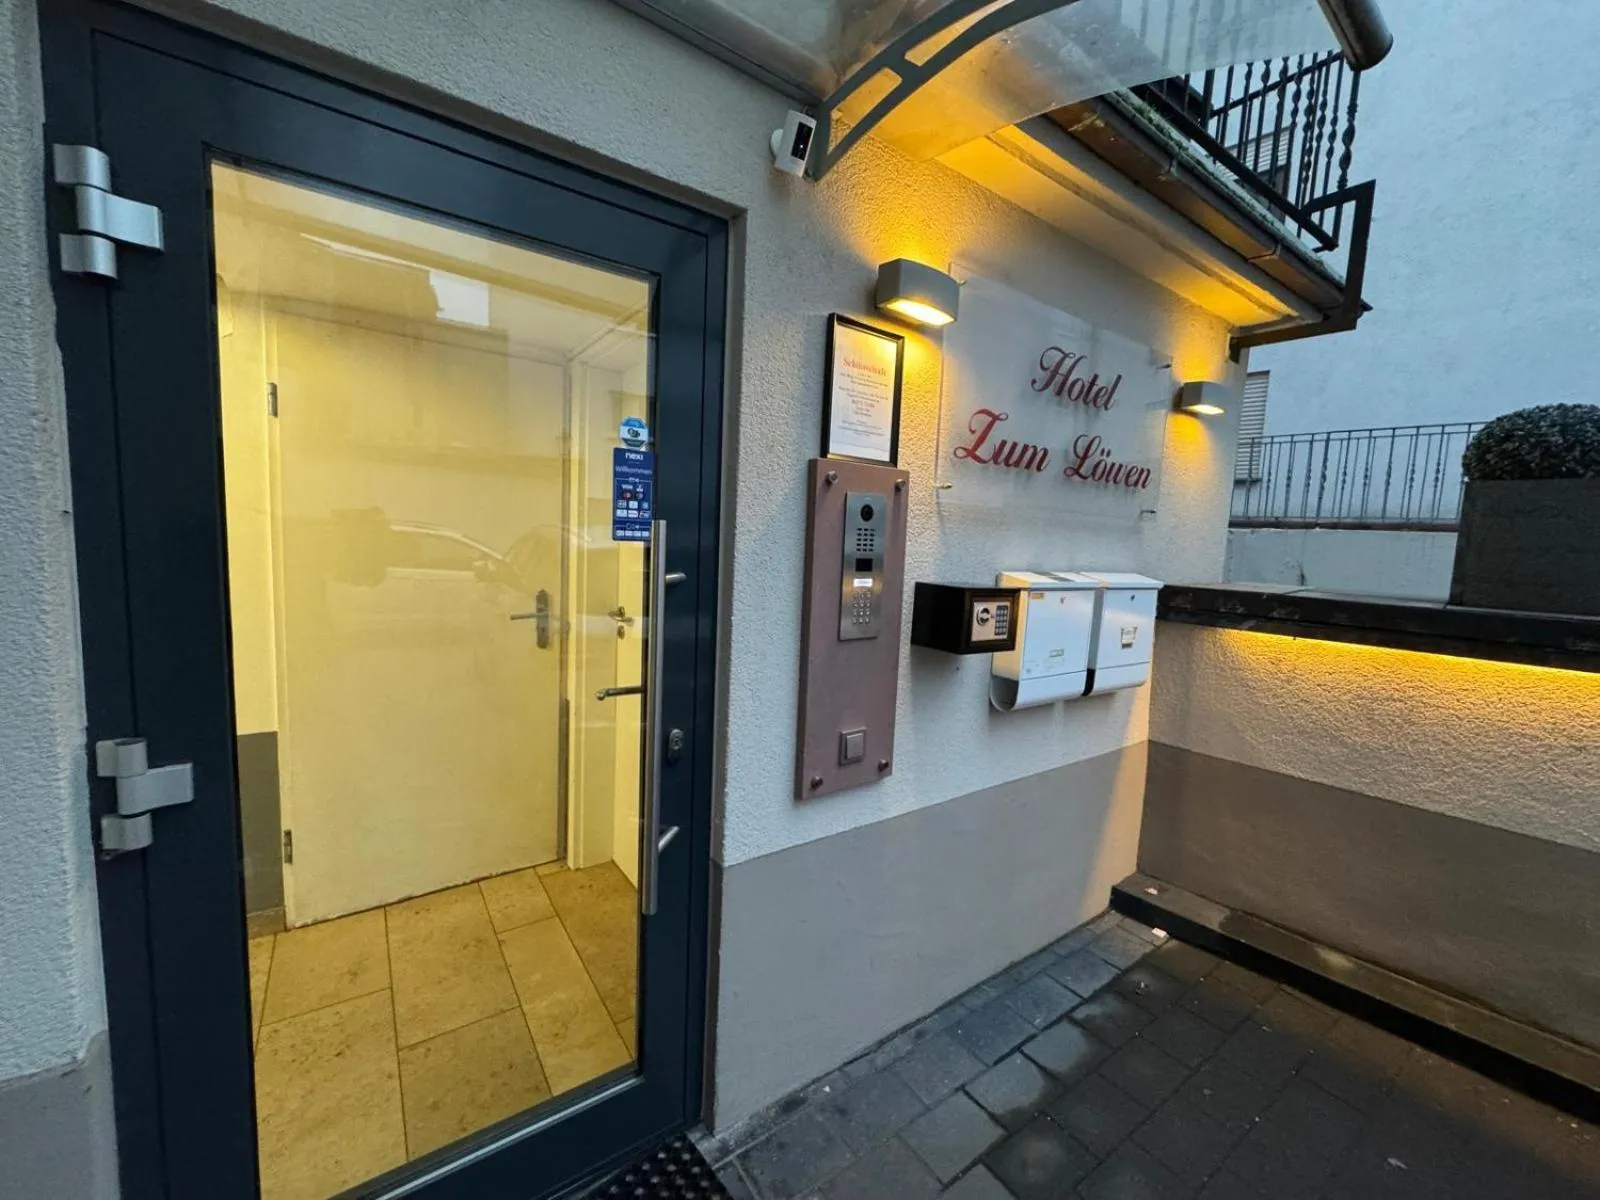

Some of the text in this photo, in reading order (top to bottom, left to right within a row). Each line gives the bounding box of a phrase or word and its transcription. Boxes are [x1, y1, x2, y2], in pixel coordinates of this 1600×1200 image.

[1030, 346, 1123, 411] Hotel
[625, 453, 644, 461] nexi
[953, 408, 1152, 489] Zum Löwen
[615, 466, 652, 475] Willkommen
